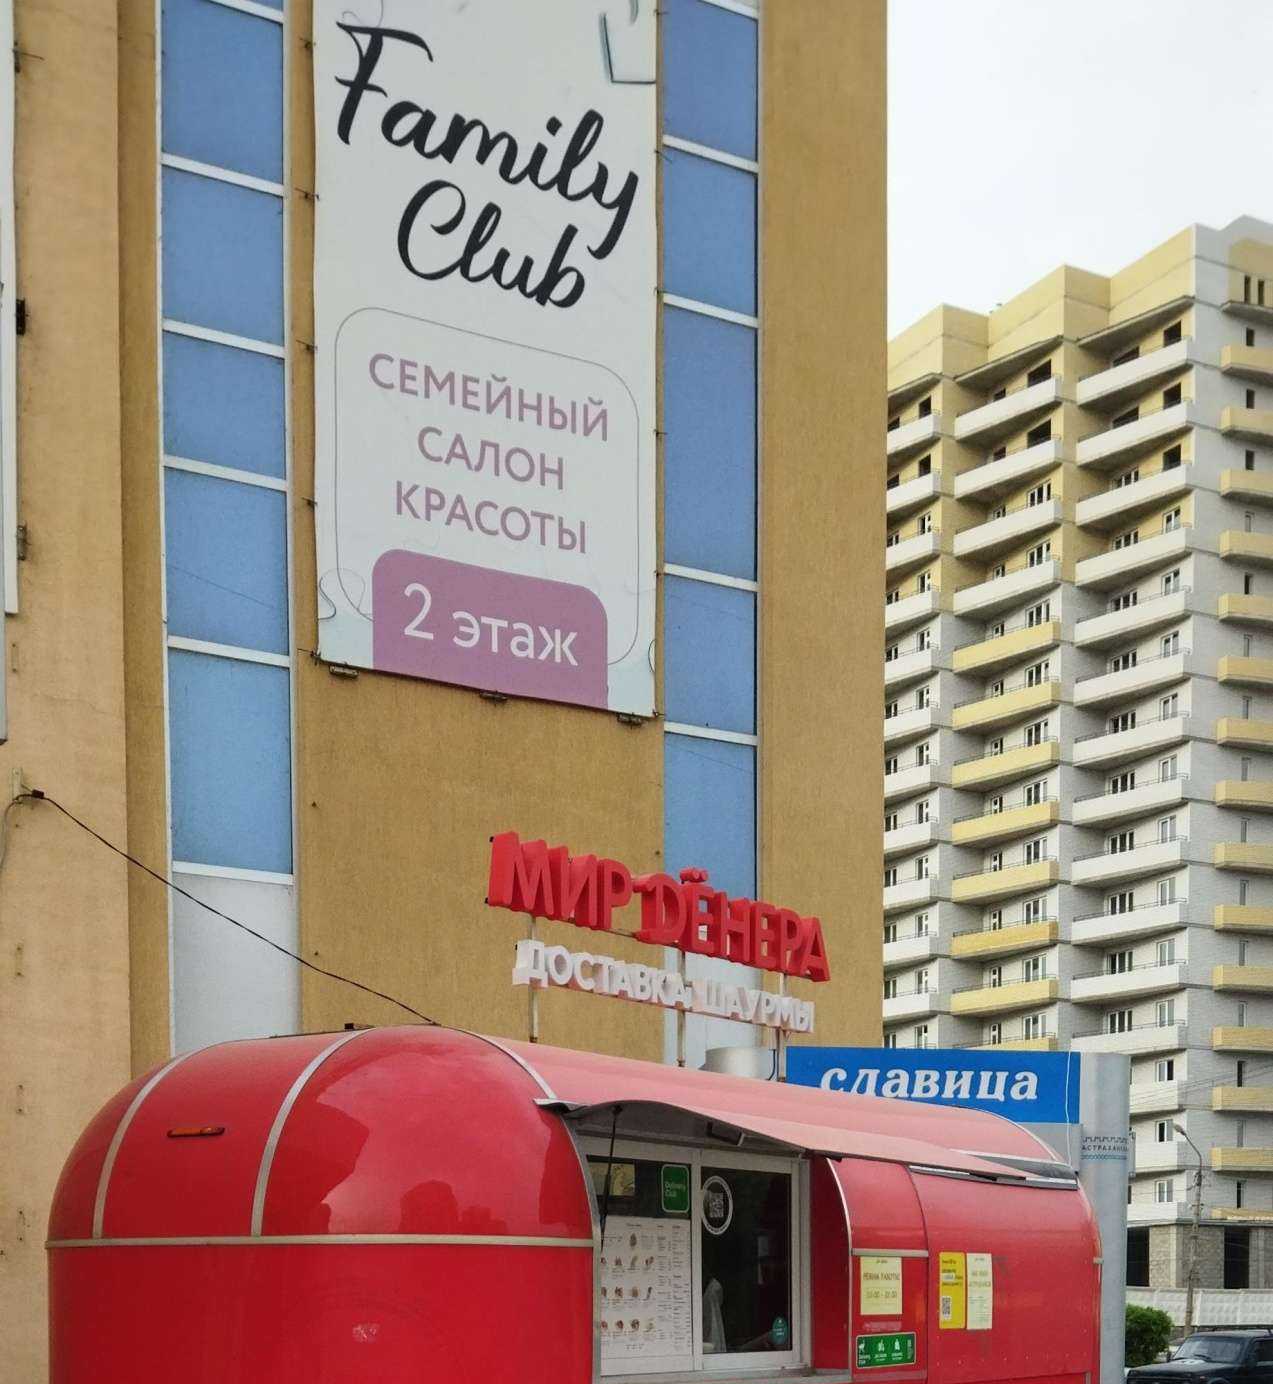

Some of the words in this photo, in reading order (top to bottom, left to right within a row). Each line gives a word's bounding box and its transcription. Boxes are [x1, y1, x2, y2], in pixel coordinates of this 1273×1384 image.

[335, 21, 639, 260] Family
[398, 180, 585, 308] Club
[369, 353, 608, 442] СЕМЕЙНЫЙ
[418, 426, 564, 490] САЛОН
[396, 481, 586, 553] КРАСОТЫ
[403, 583, 434, 640] 2
[452, 611, 578, 666] этаж
[488, 831, 632, 931] МИР
[512, 939, 692, 1009] ДОСТАВКА
[692, 978, 815, 1033] ШАУРМЫ
[820, 1067, 1038, 1101] славица
